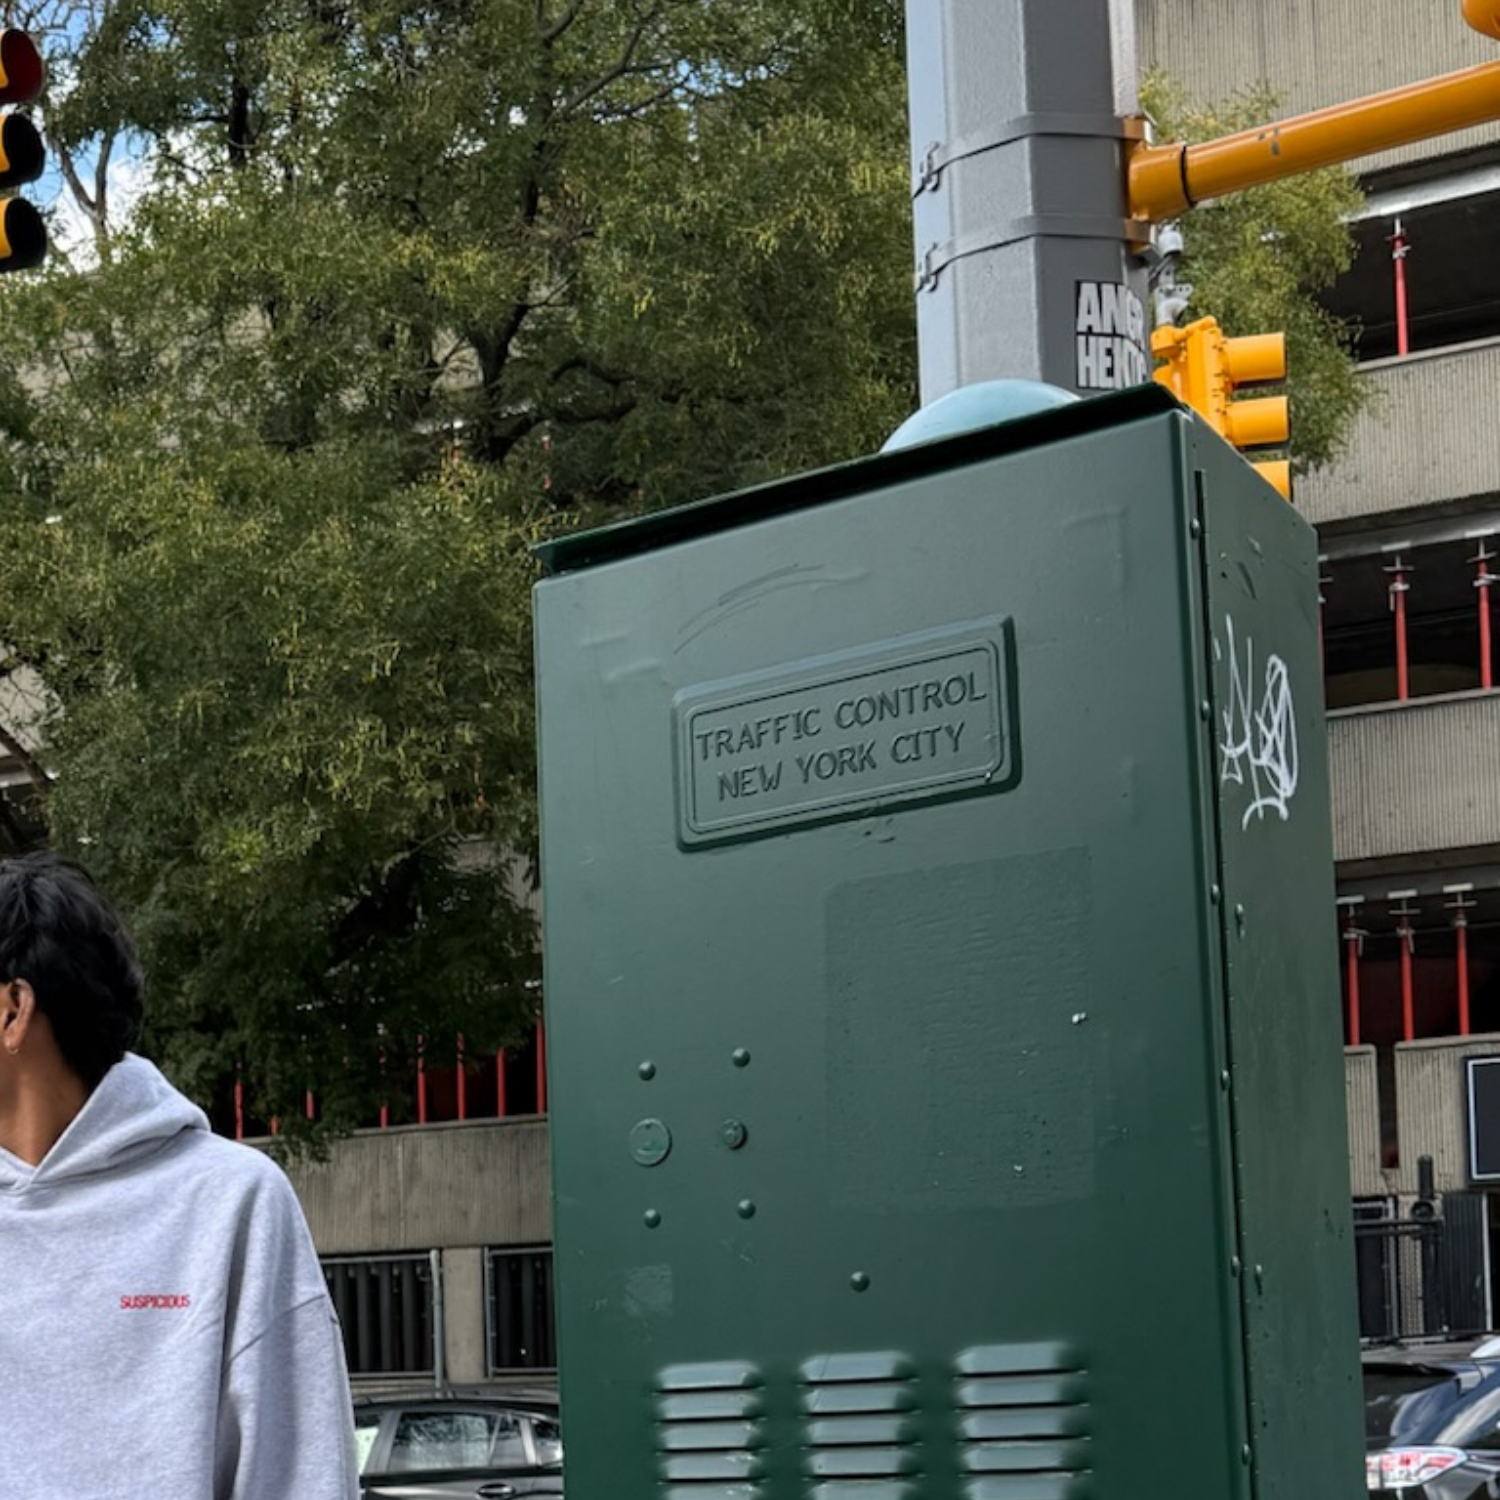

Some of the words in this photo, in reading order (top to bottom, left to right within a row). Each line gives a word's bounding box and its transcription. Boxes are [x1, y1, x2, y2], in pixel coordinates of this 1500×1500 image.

[696, 707, 822, 761] TRAFFIC
[835, 671, 988, 730] CONTROL
[717, 761, 783, 802] NEW
[796, 740, 878, 785] YORK
[890, 721, 966, 764] CITY
[119, 1294, 191, 1310] SUSPICIOUS
